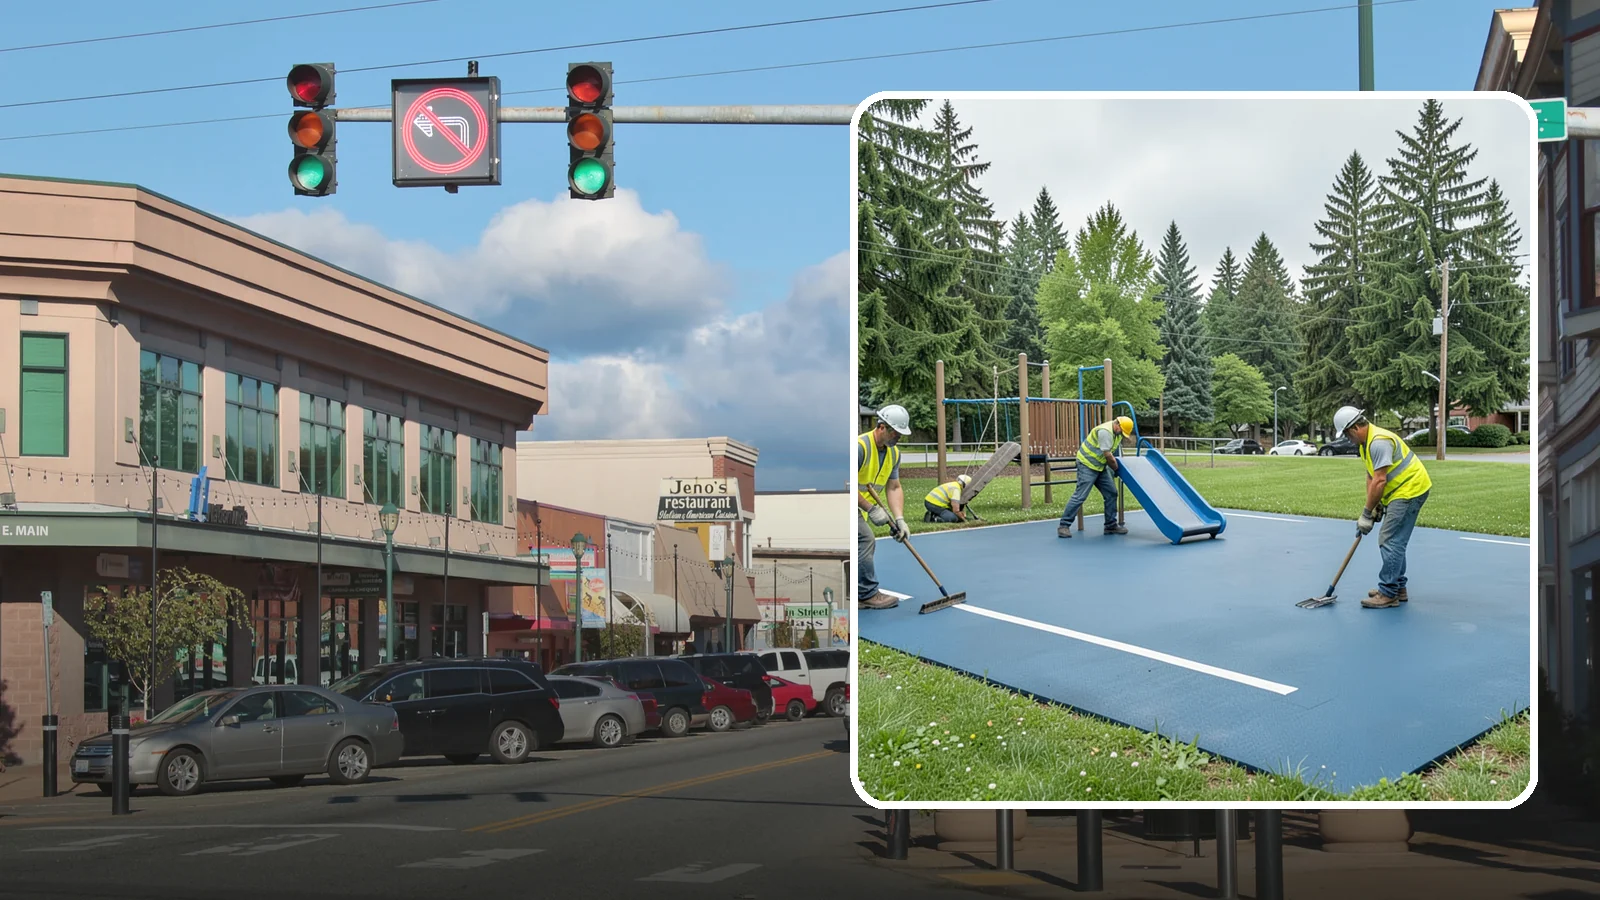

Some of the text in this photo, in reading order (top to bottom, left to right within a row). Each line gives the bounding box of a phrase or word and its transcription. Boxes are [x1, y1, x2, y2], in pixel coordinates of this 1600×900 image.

[669, 480, 727, 494] Jeno's
[665, 496, 731, 509] restaurant
[659, 510, 681, 520] Italian
[686, 510, 714, 519] American
[715, 509, 738, 519] Cuisine
[2, 525, 49, 536] E. MAIN
[797, 607, 828, 617] Street
